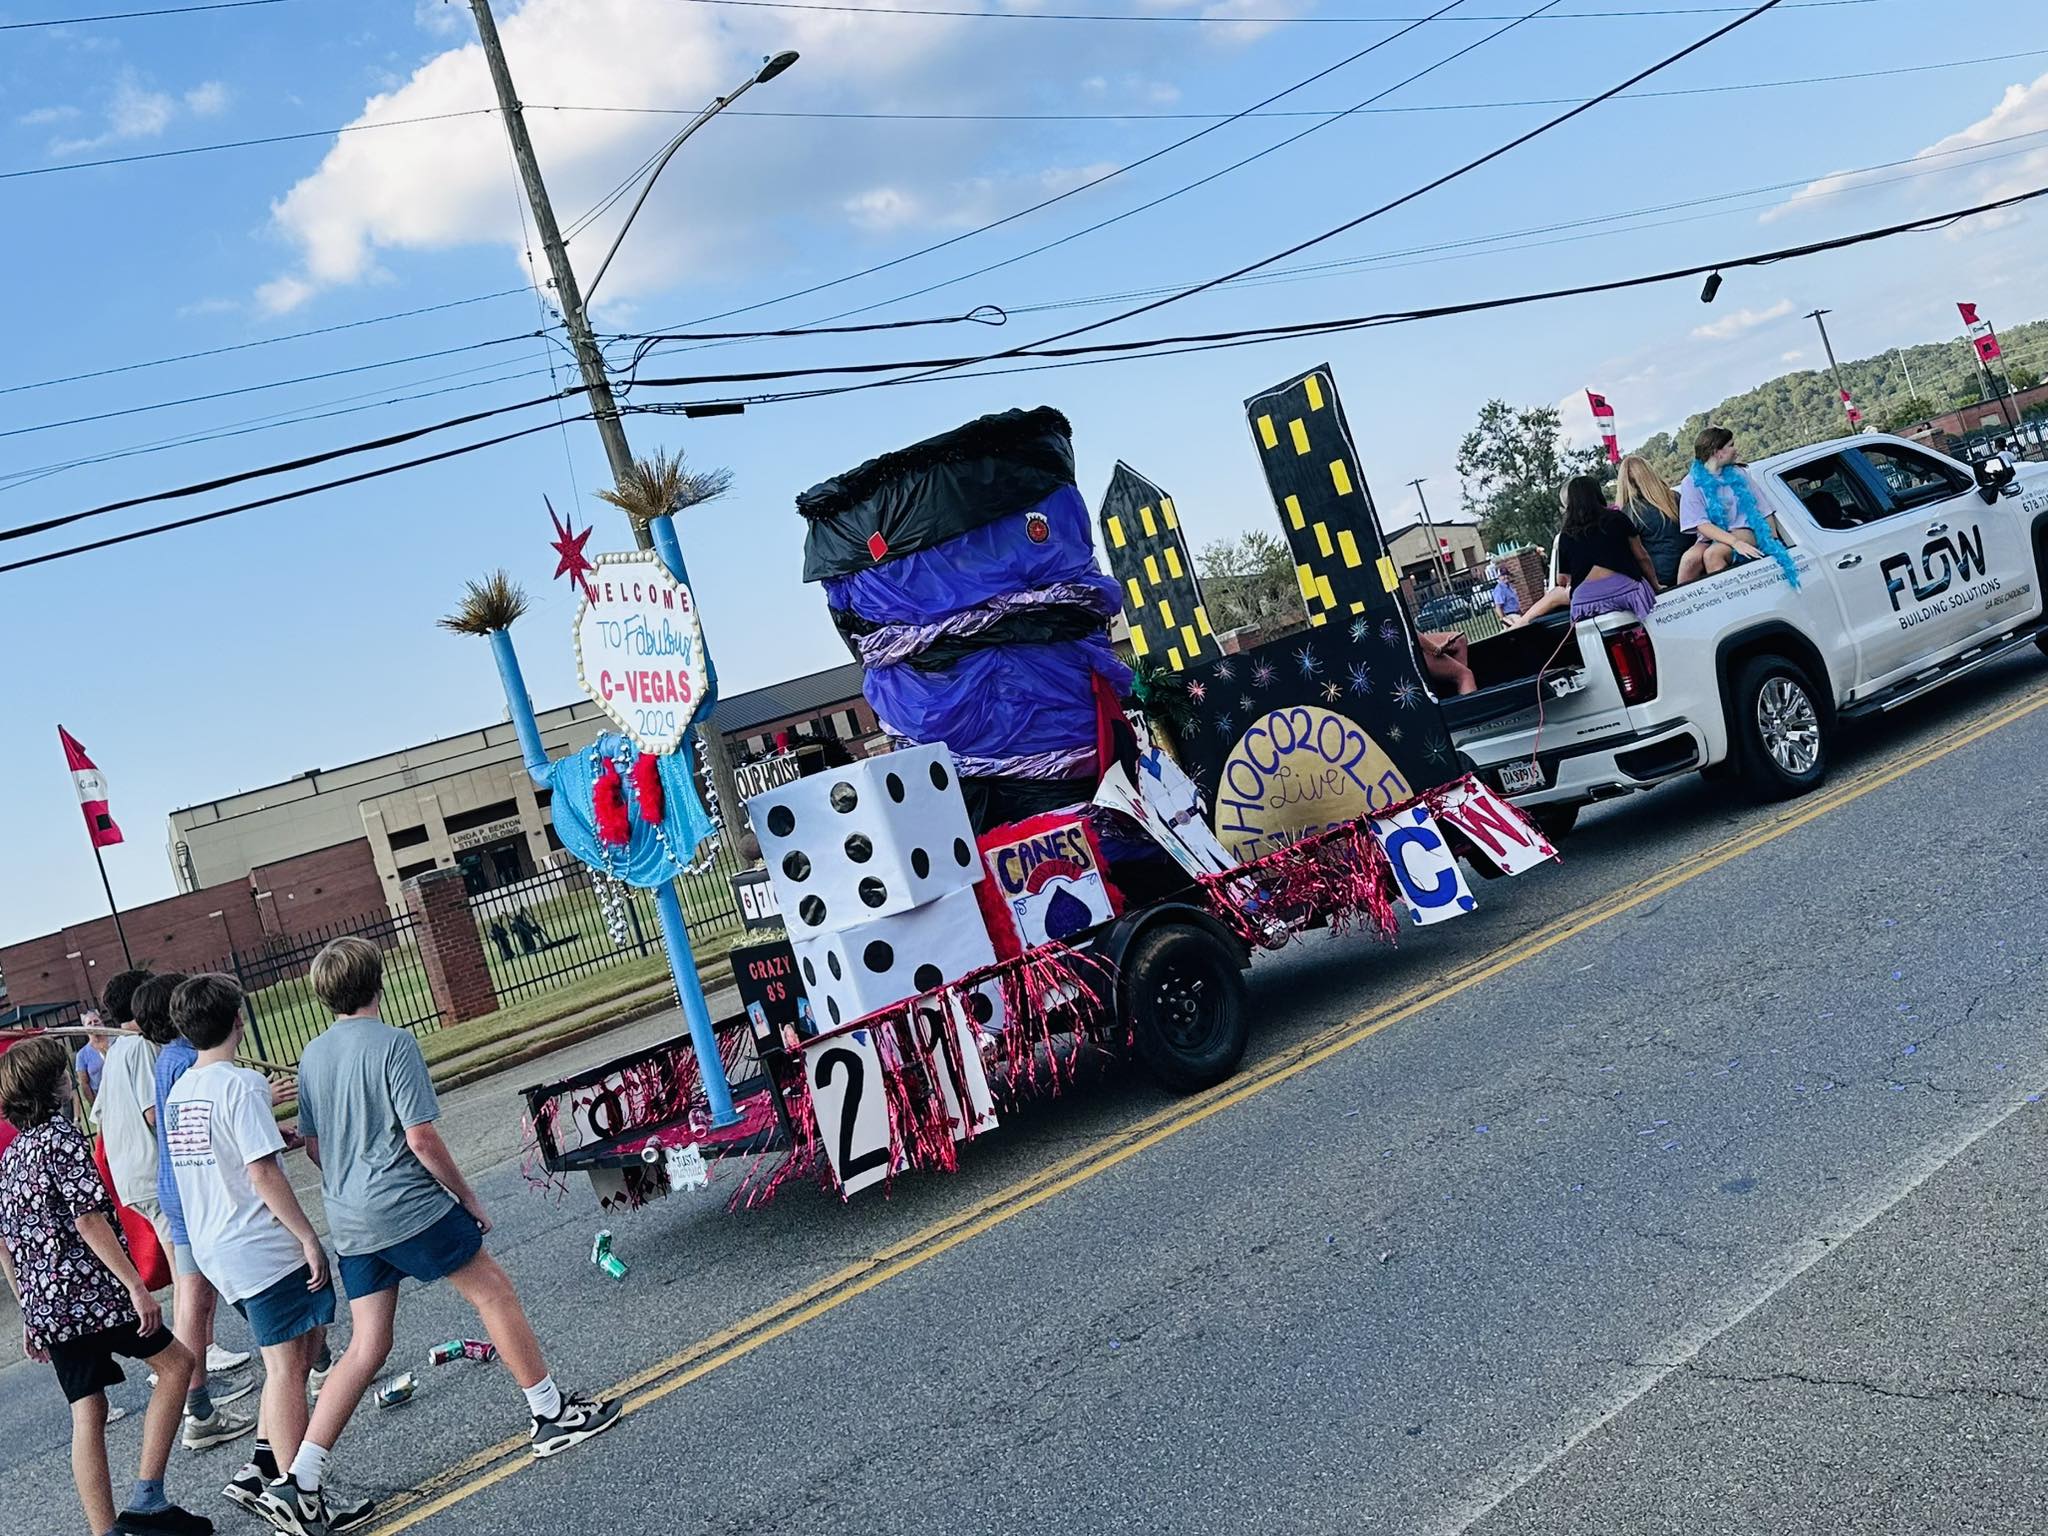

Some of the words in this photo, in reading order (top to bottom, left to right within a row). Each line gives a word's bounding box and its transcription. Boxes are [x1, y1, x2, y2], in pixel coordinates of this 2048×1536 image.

[1880, 524, 1986, 612] FLOW
[588, 582, 690, 613] WELCOME
[1655, 607, 1694, 626] Mechanical
[1692, 598, 1722, 612] Services
[1725, 588, 1749, 600] Energy
[1686, 586, 1708, 599] HVAC
[1898, 600, 1950, 630] BUILDING
[1949, 577, 2001, 611] SOLUTIONS
[596, 621, 622, 649] TO
[600, 670, 692, 703] C-VEGAS
[635, 708, 676, 737] 2029
[735, 763, 765, 800] OUR
[1269, 765, 1347, 809] Live
[452, 831, 478, 844] LINDA
[488, 818, 521, 833] BENTON
[458, 838, 480, 850] STEM
[481, 826, 520, 843] BUILDING
[997, 828, 1091, 895] CANES
[748, 955, 792, 981] CRAZY
[766, 981, 786, 1002] 8'S
